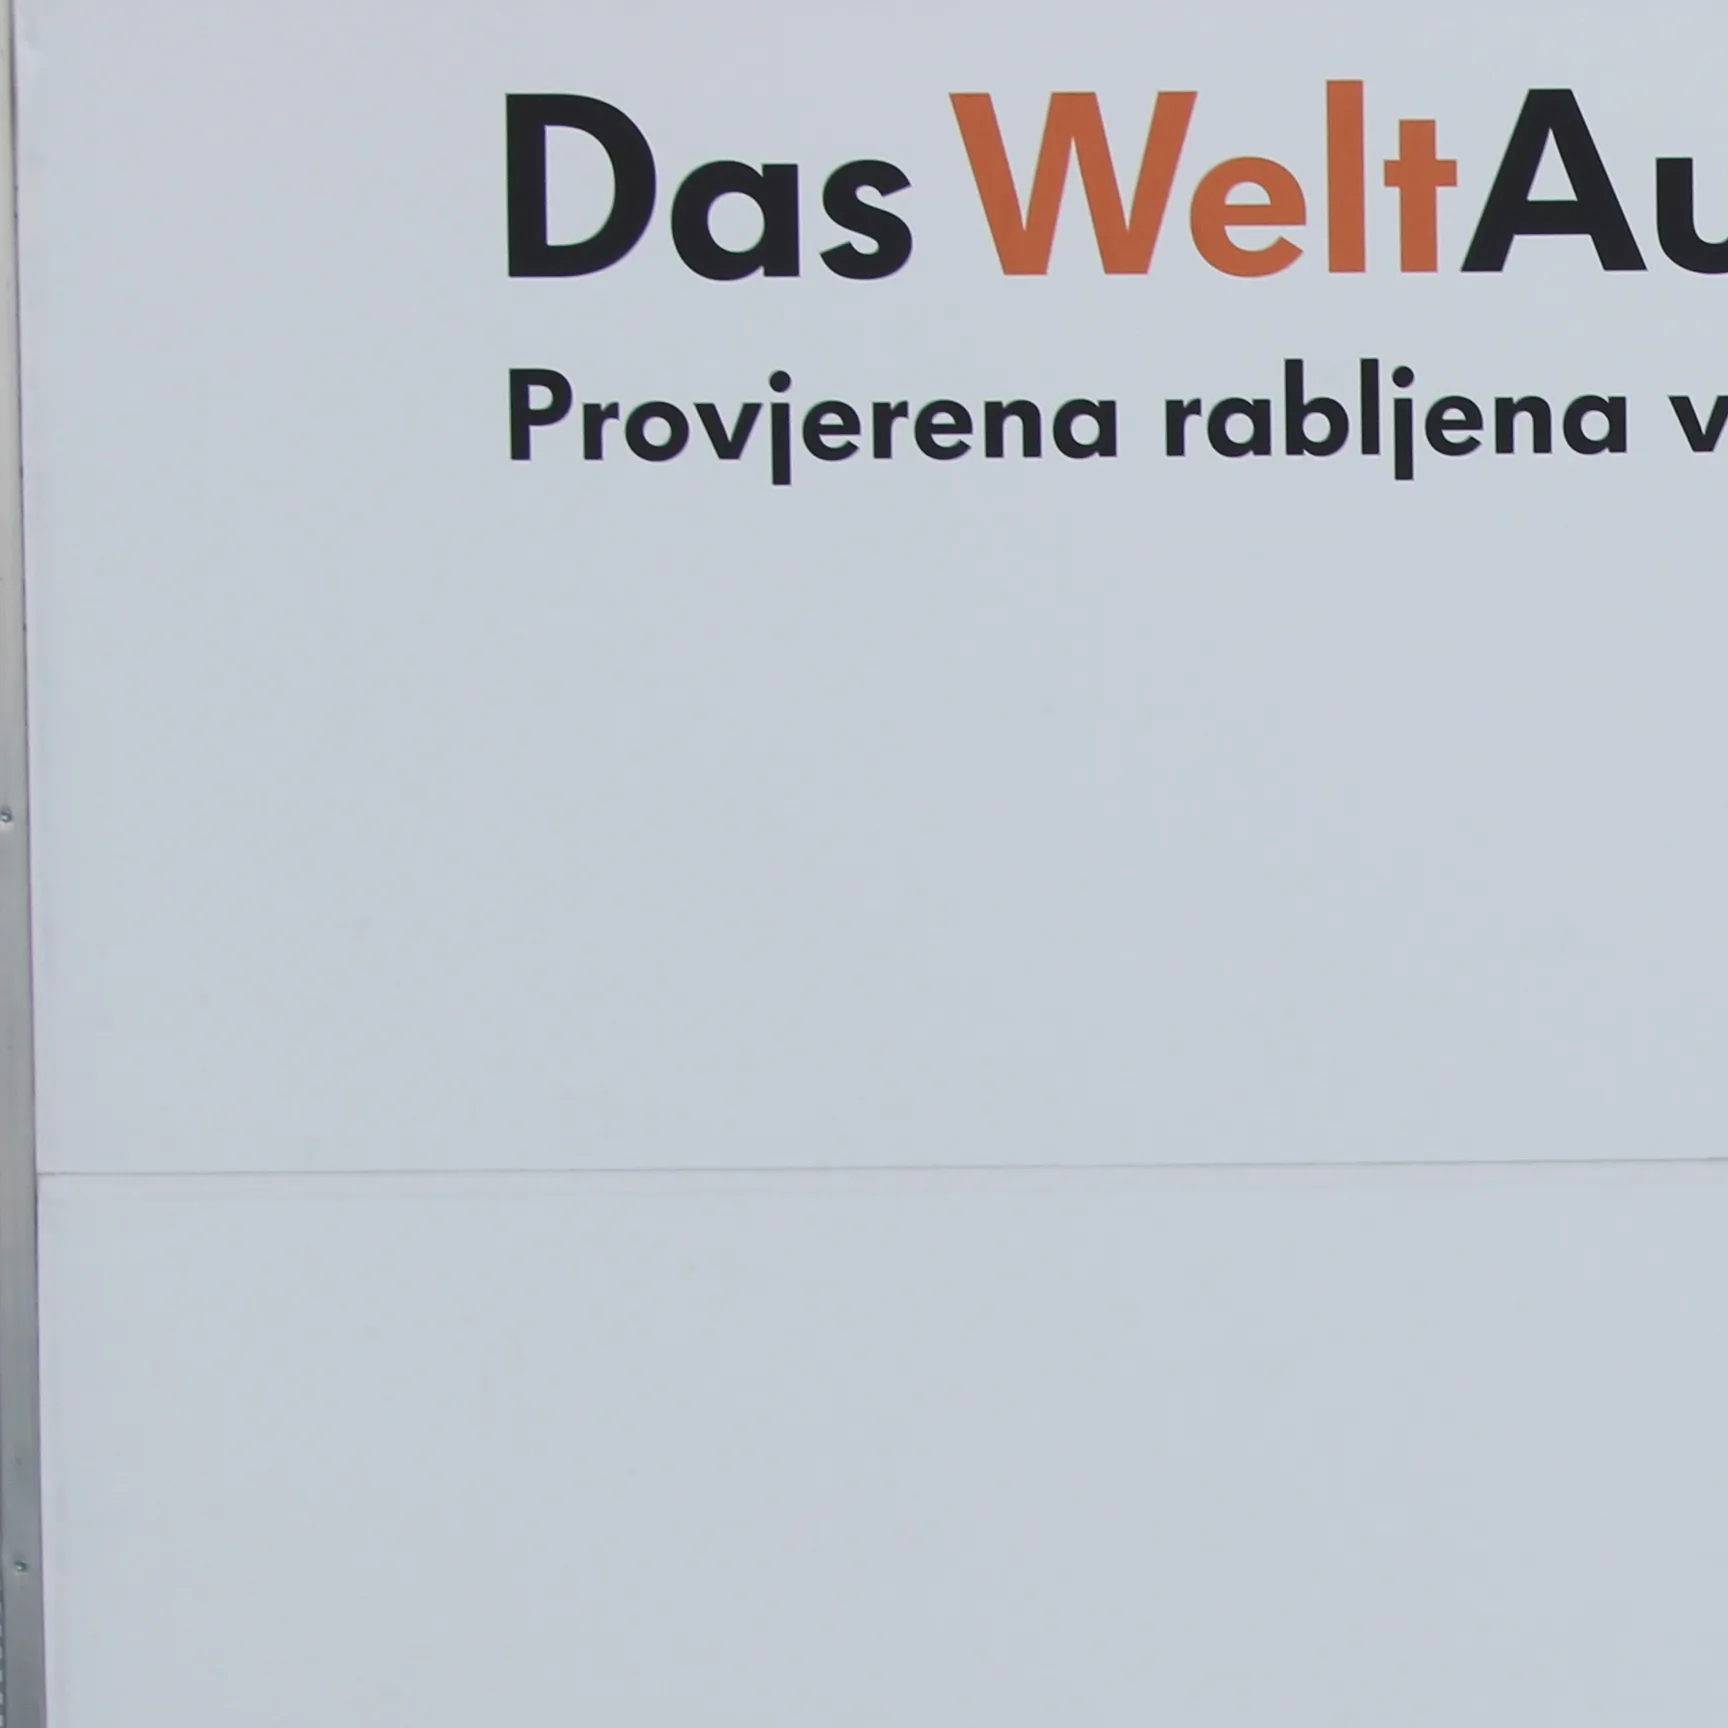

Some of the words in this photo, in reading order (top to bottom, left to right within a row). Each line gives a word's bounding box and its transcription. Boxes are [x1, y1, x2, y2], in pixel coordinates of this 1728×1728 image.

[505, 93, 914, 282] Das
[508, 367, 1118, 486] Provjerena
[1165, 357, 1627, 481] rabljena
